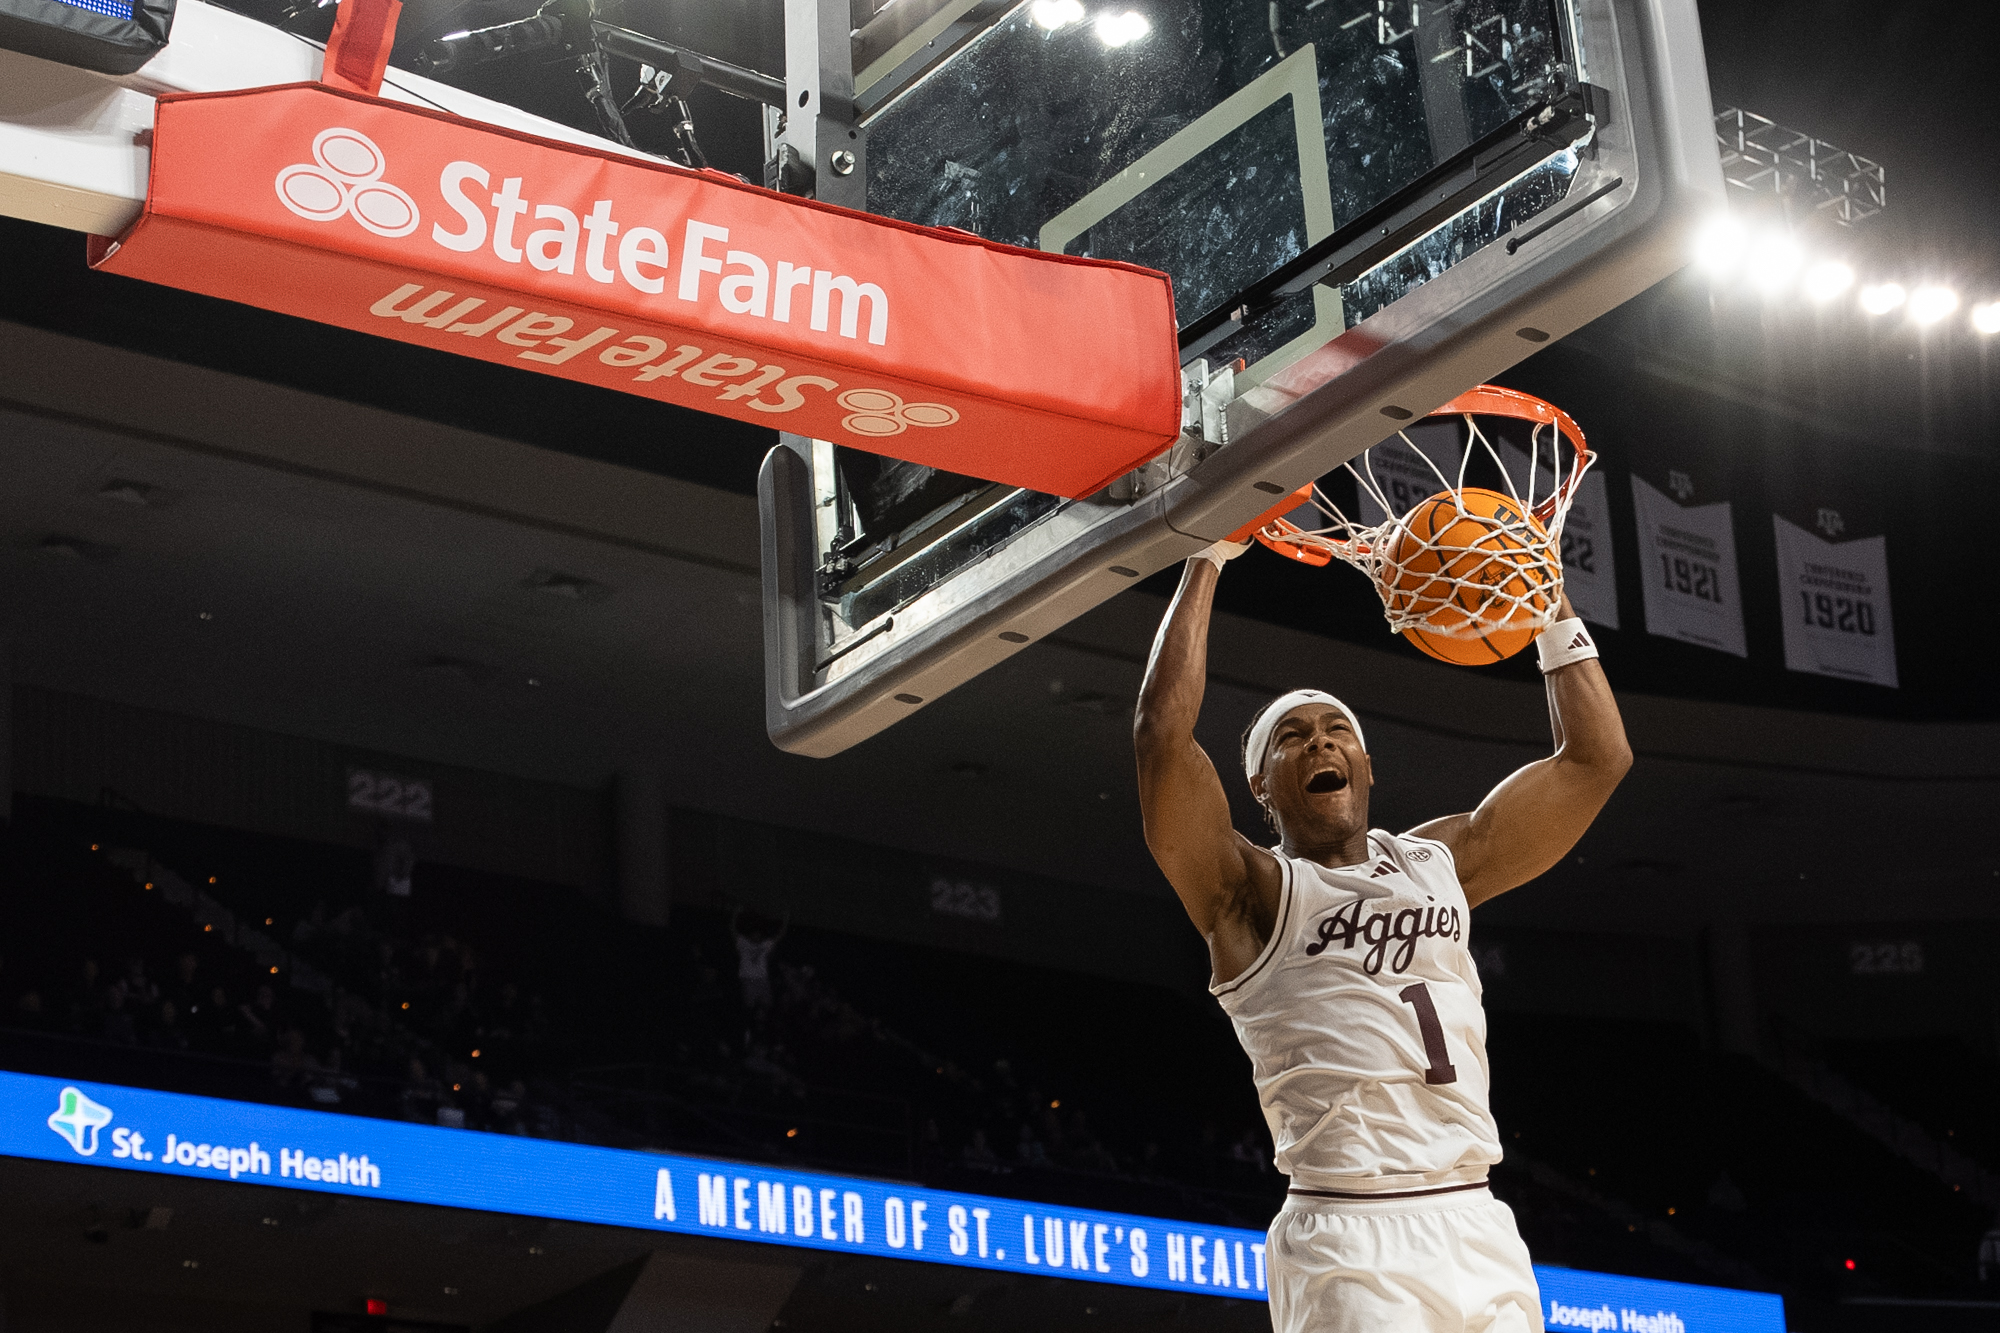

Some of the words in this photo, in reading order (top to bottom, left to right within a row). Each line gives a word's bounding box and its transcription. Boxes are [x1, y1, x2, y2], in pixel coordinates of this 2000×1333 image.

[1660, 553, 1723, 604] 1921
[1800, 590, 1876, 636] 1920
[349, 770, 431, 819] 222
[930, 880, 1000, 920] 223
[1305, 895, 1460, 975] Aggies
[1398, 982, 1457, 1085] 1
[112, 1127, 153, 1161] St.
[162, 1133, 271, 1179] Joseph
[280, 1147, 381, 1188] Health
[654, 1168, 677, 1222] A
[698, 1173, 864, 1244] MEMBER
[885, 1196, 928, 1250] OF
[948, 1204, 1005, 1260] ST.
[1023, 1213, 1149, 1278] LUKE'S
[1166, 1232, 1267, 1292] HEALT
[1550, 1300, 1618, 1333] Joseph
[1621, 1307, 1686, 1333] Health
